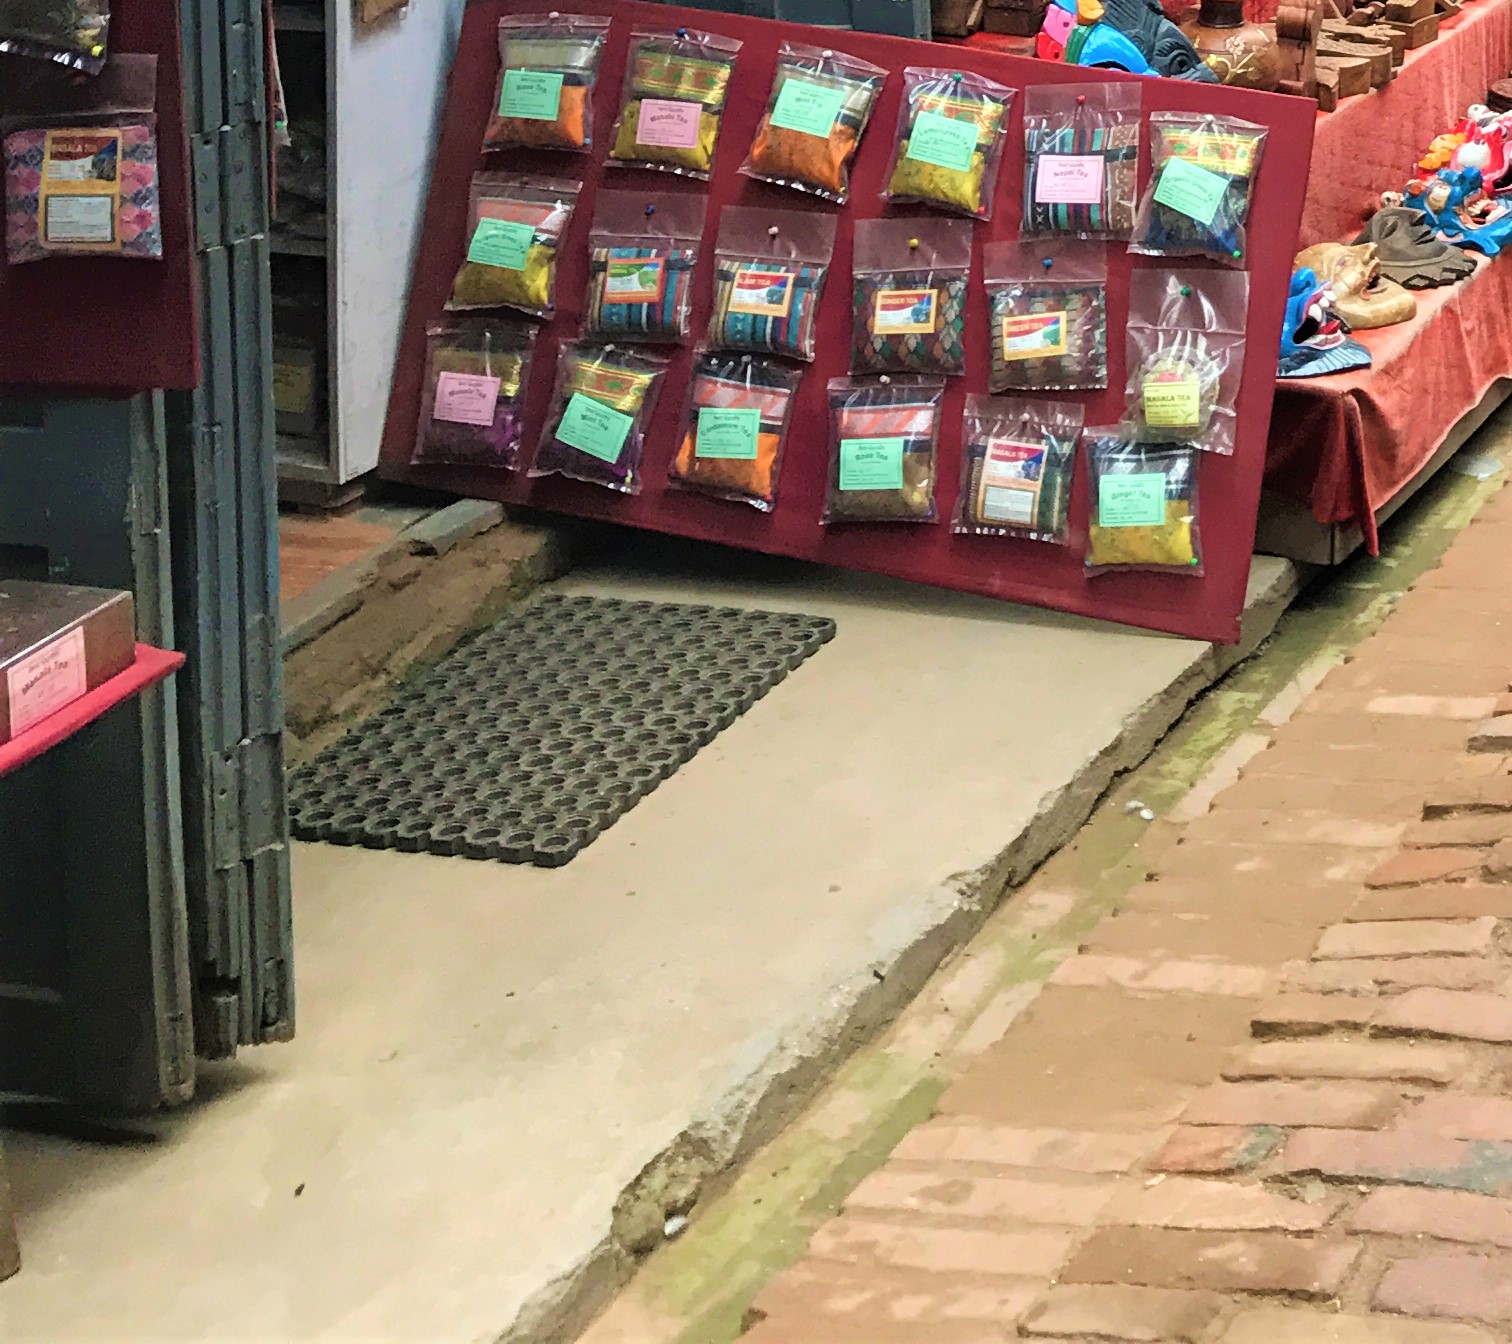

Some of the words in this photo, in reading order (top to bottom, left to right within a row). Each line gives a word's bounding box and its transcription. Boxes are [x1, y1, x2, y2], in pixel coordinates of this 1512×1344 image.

[1077, 169, 1089, 178] Tea
[1146, 395, 1175, 403] MASALA
[741, 424, 752, 438] Tea
[876, 452, 889, 461] Tea
[1139, 490, 1151, 499] Tea
